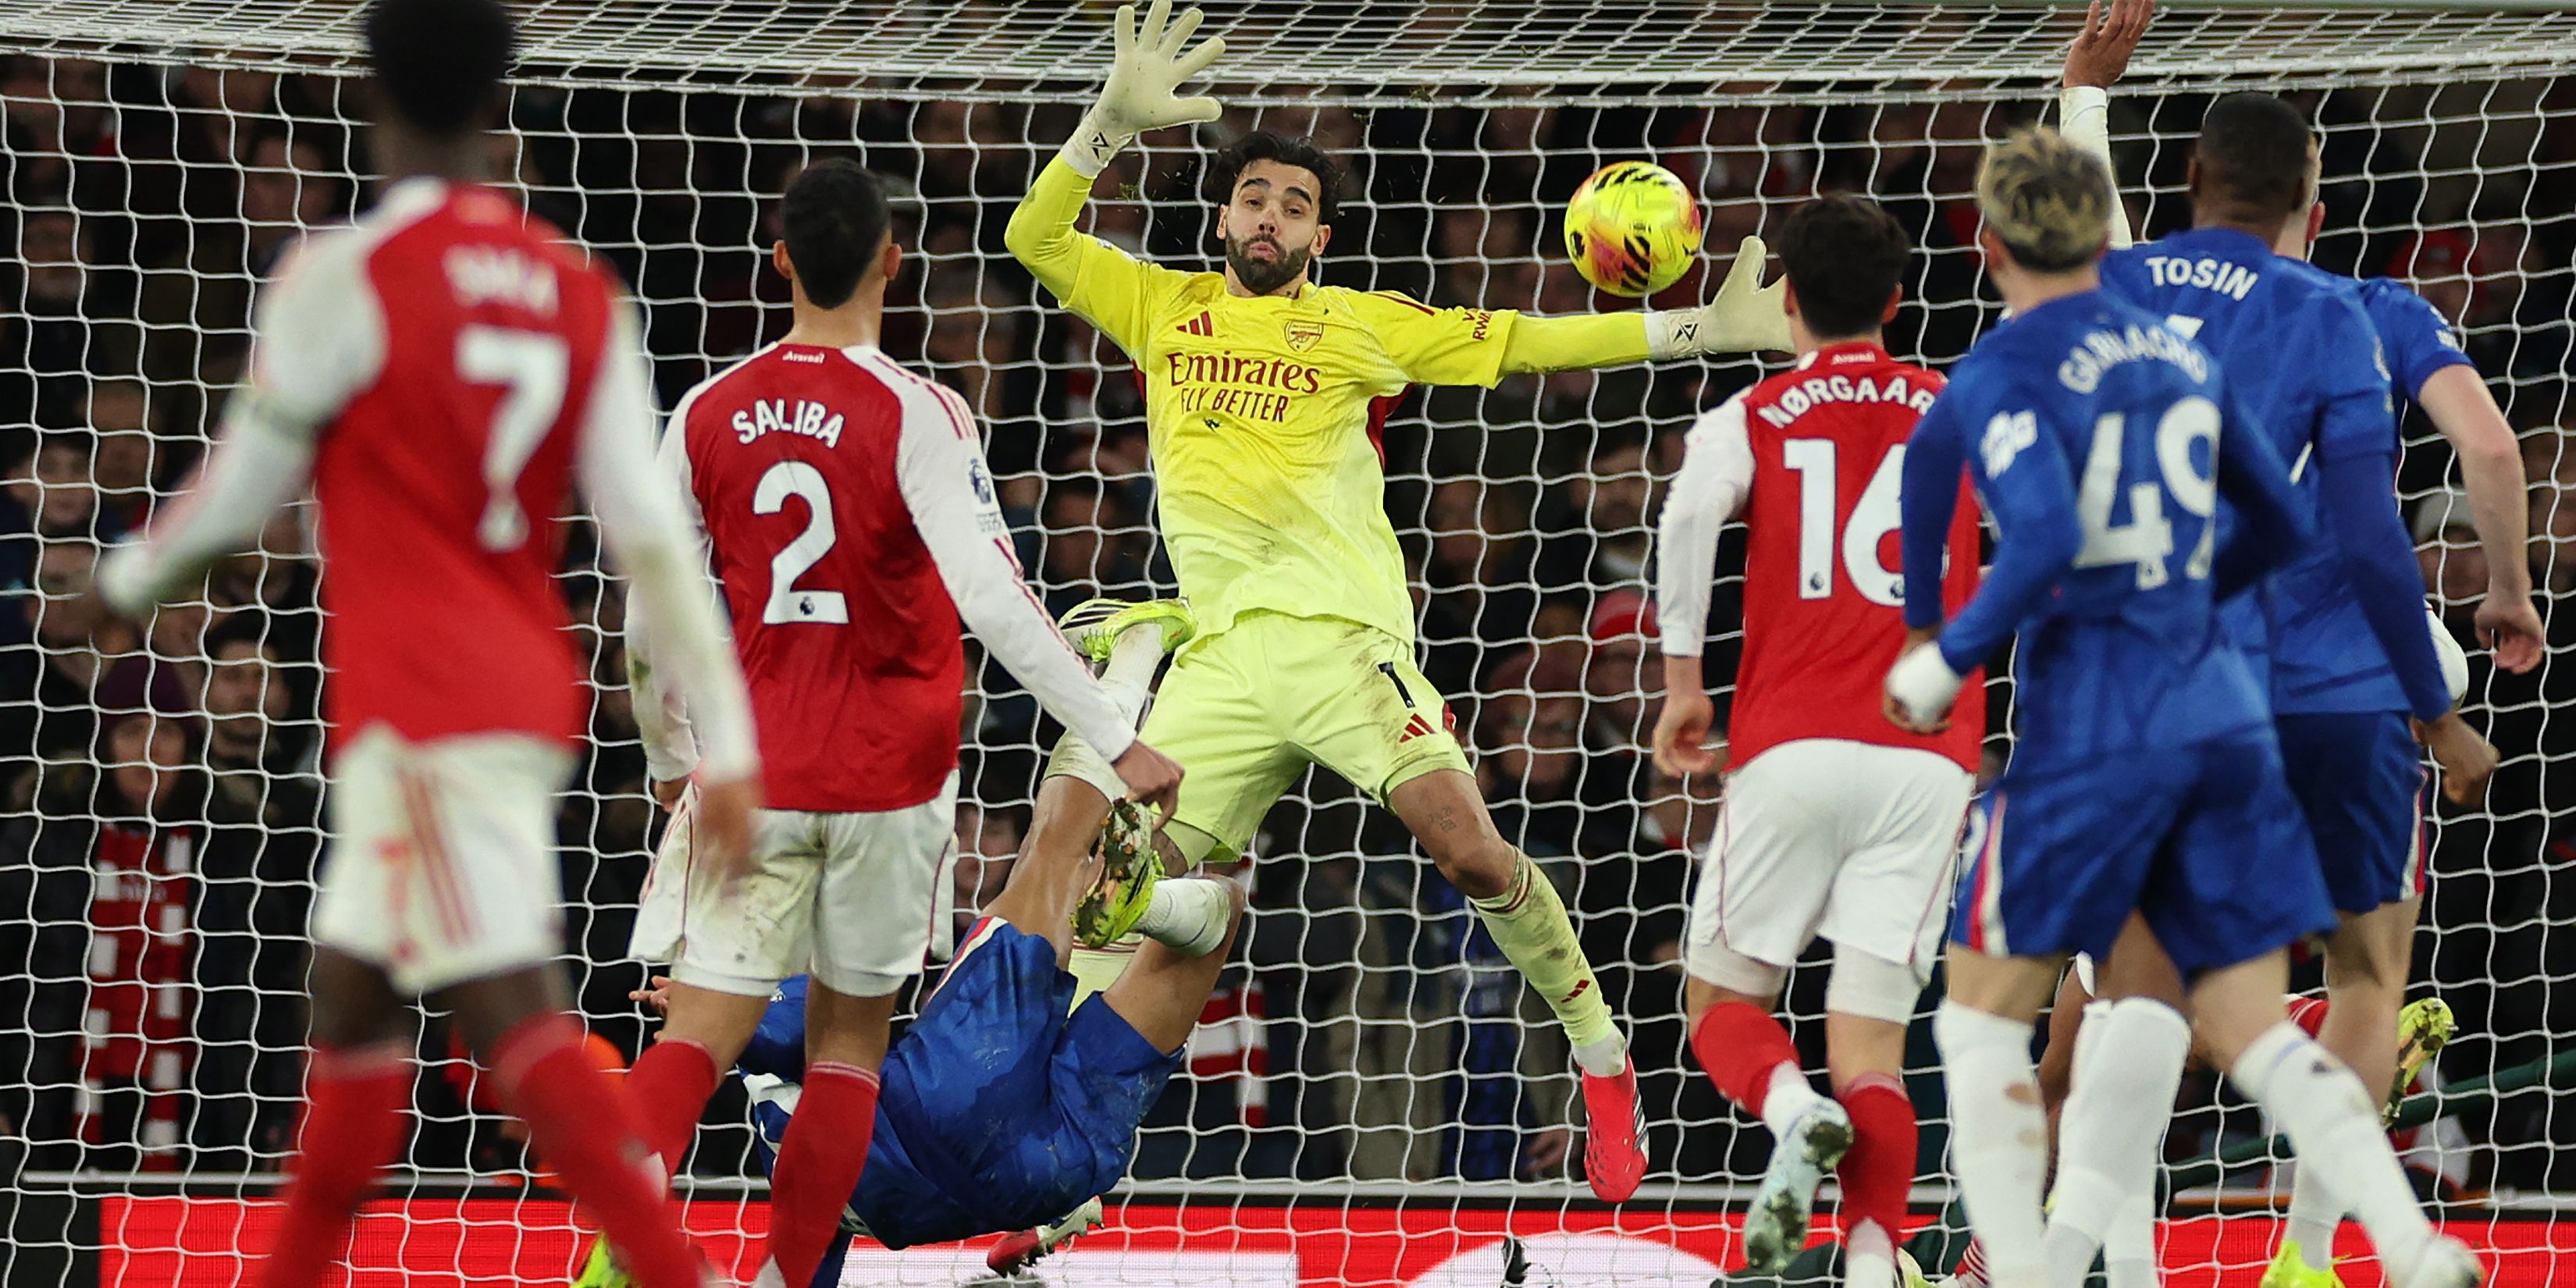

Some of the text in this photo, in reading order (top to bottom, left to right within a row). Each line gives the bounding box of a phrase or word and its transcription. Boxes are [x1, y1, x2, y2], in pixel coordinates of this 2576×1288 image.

[2144, 255, 2259, 301] TOSIN
[1166, 350, 1321, 394] Emirates
[731, 398, 845, 449] SALIBA
[1181, 387, 1290, 423] FLY BETTER
[1757, 375, 1936, 429] NØRGAAR
[454, 323, 569, 553] 7
[2071, 395, 2223, 591] 49
[753, 460, 850, 624] 2
[1378, 661, 1416, 709] 1
